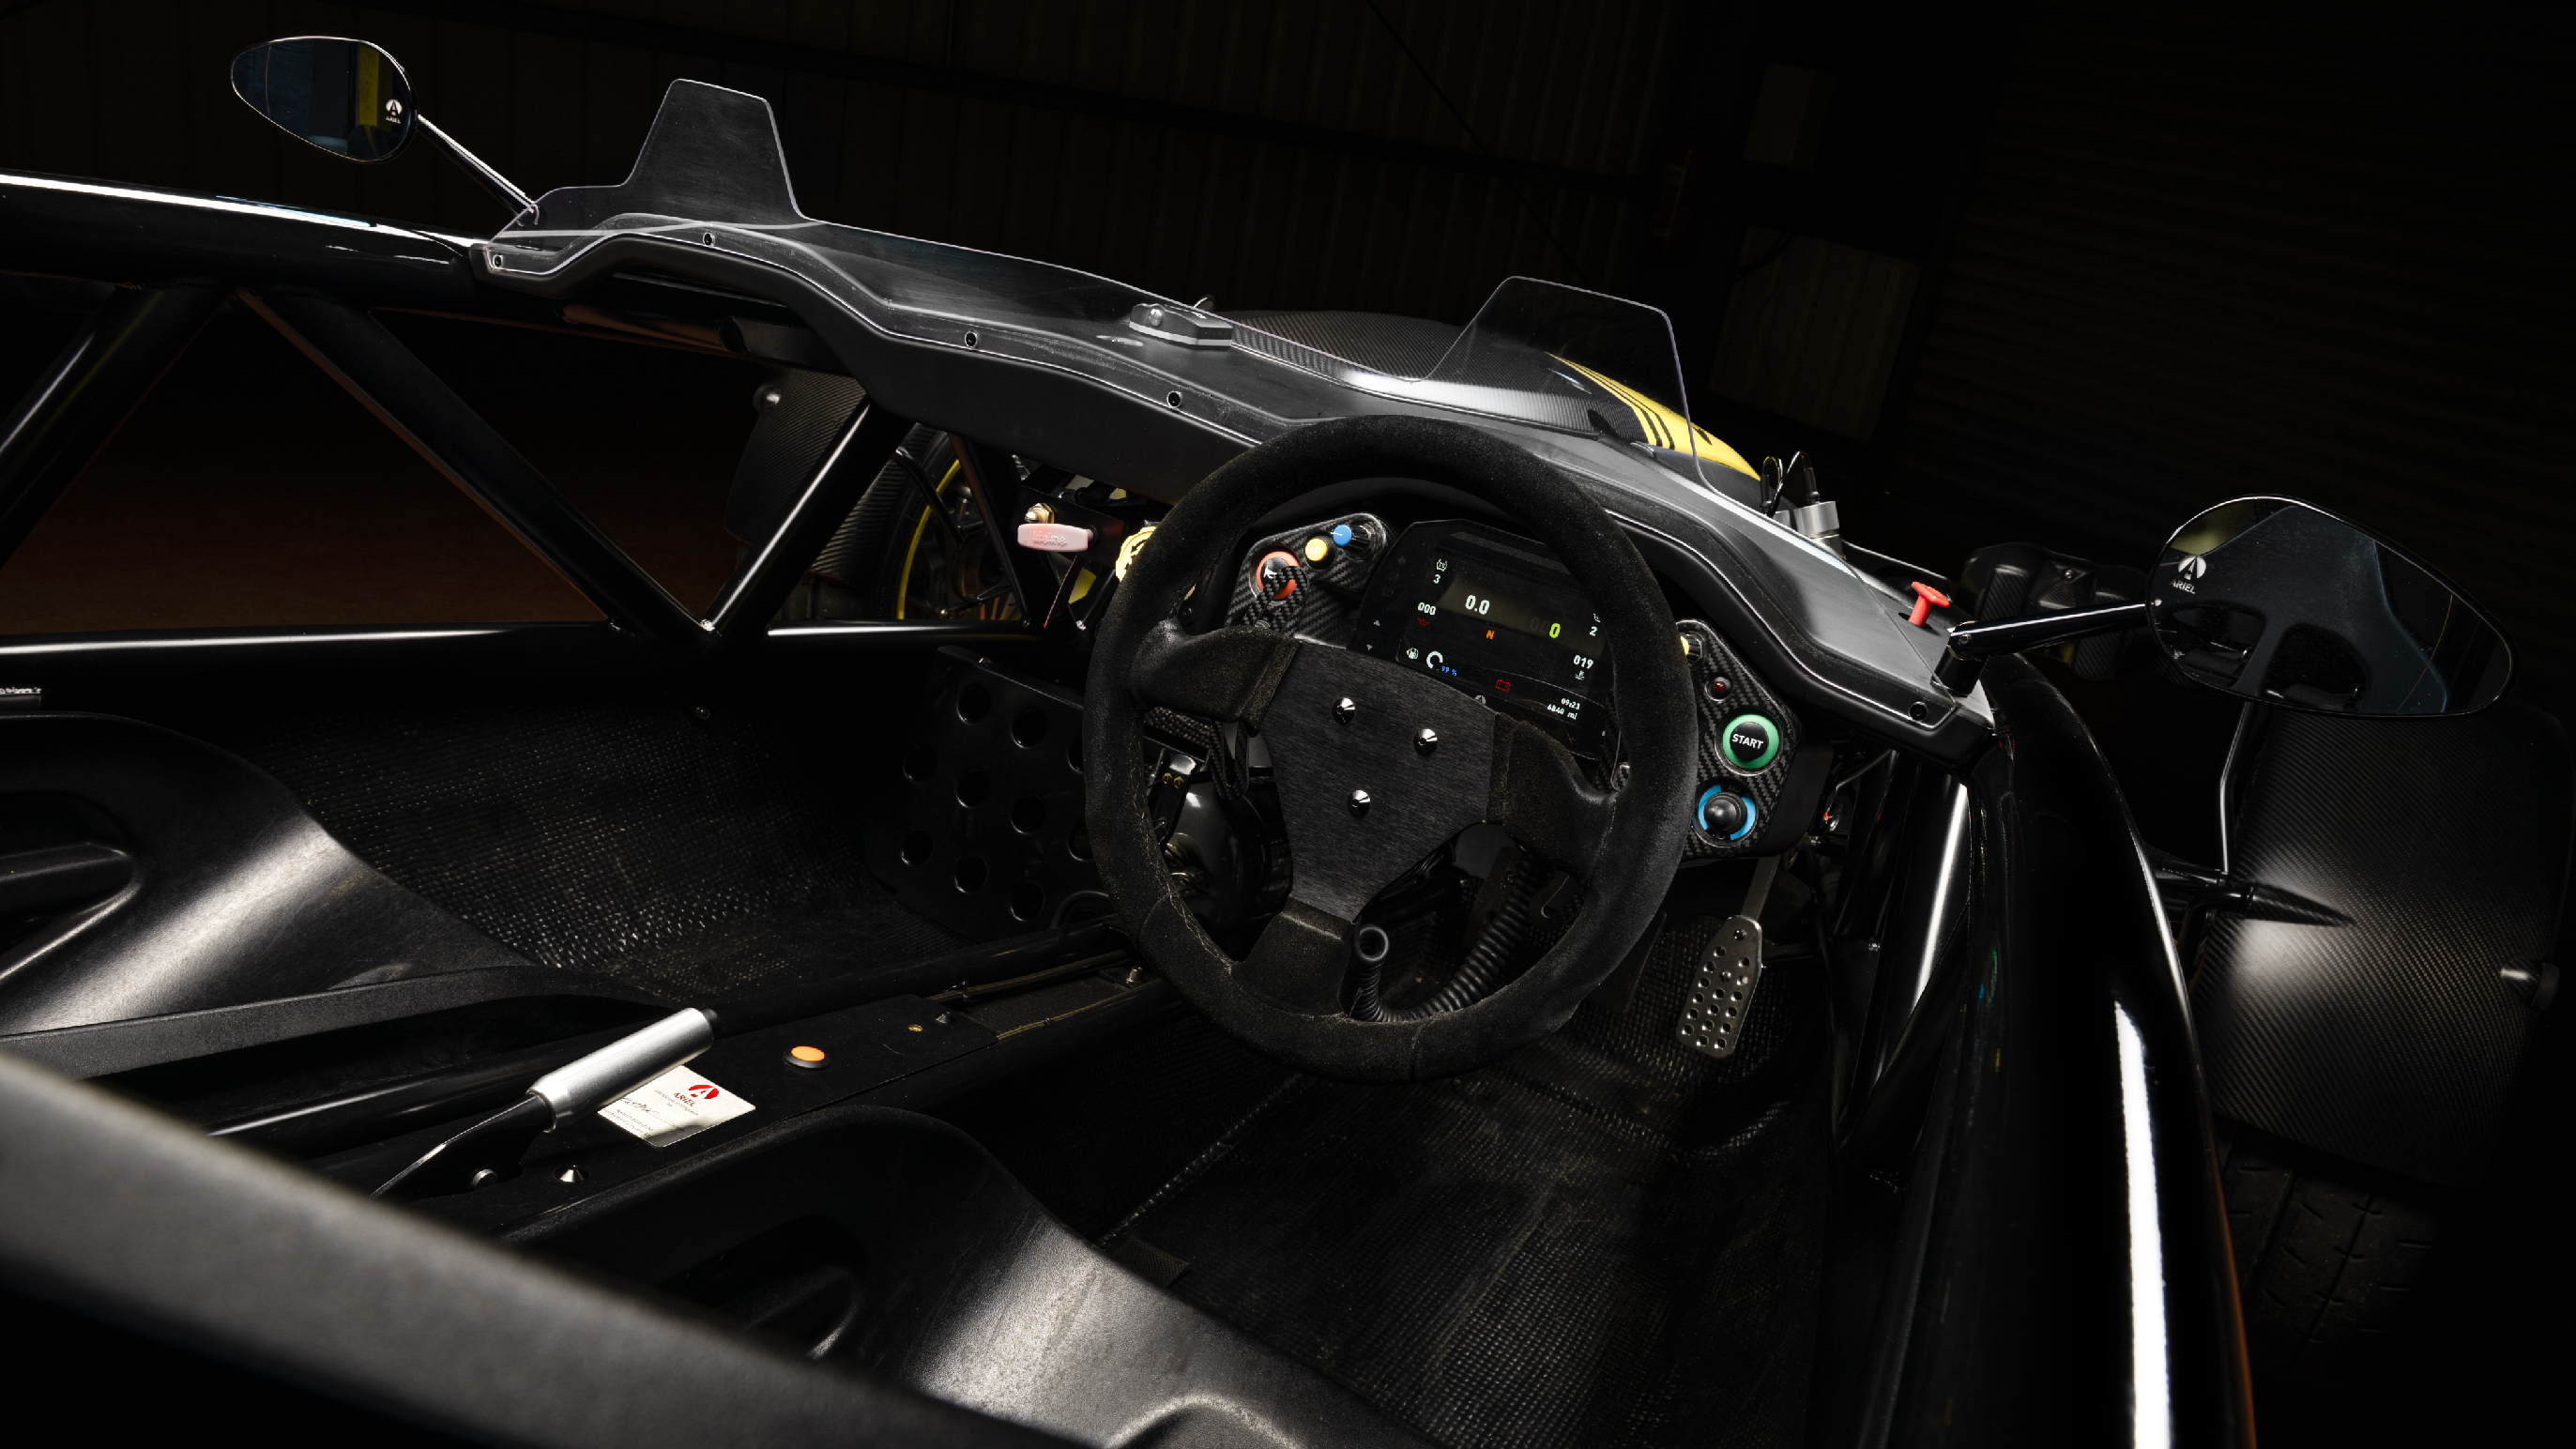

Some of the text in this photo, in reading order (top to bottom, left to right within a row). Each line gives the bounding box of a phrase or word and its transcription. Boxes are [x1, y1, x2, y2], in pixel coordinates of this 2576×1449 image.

[386, 115, 402, 124] ARIEL
[1433, 574, 1440, 584] 3
[2169, 578, 2196, 595] ARIEL
[1417, 602, 1437, 616] 000
[1464, 594, 1490, 616] 0.0
[1486, 629, 1495, 640] N
[1590, 626, 1597, 636] 2
[1573, 654, 1594, 670] 019
[1731, 733, 1764, 750] START
[673, 1091, 696, 1107] ARIEL
